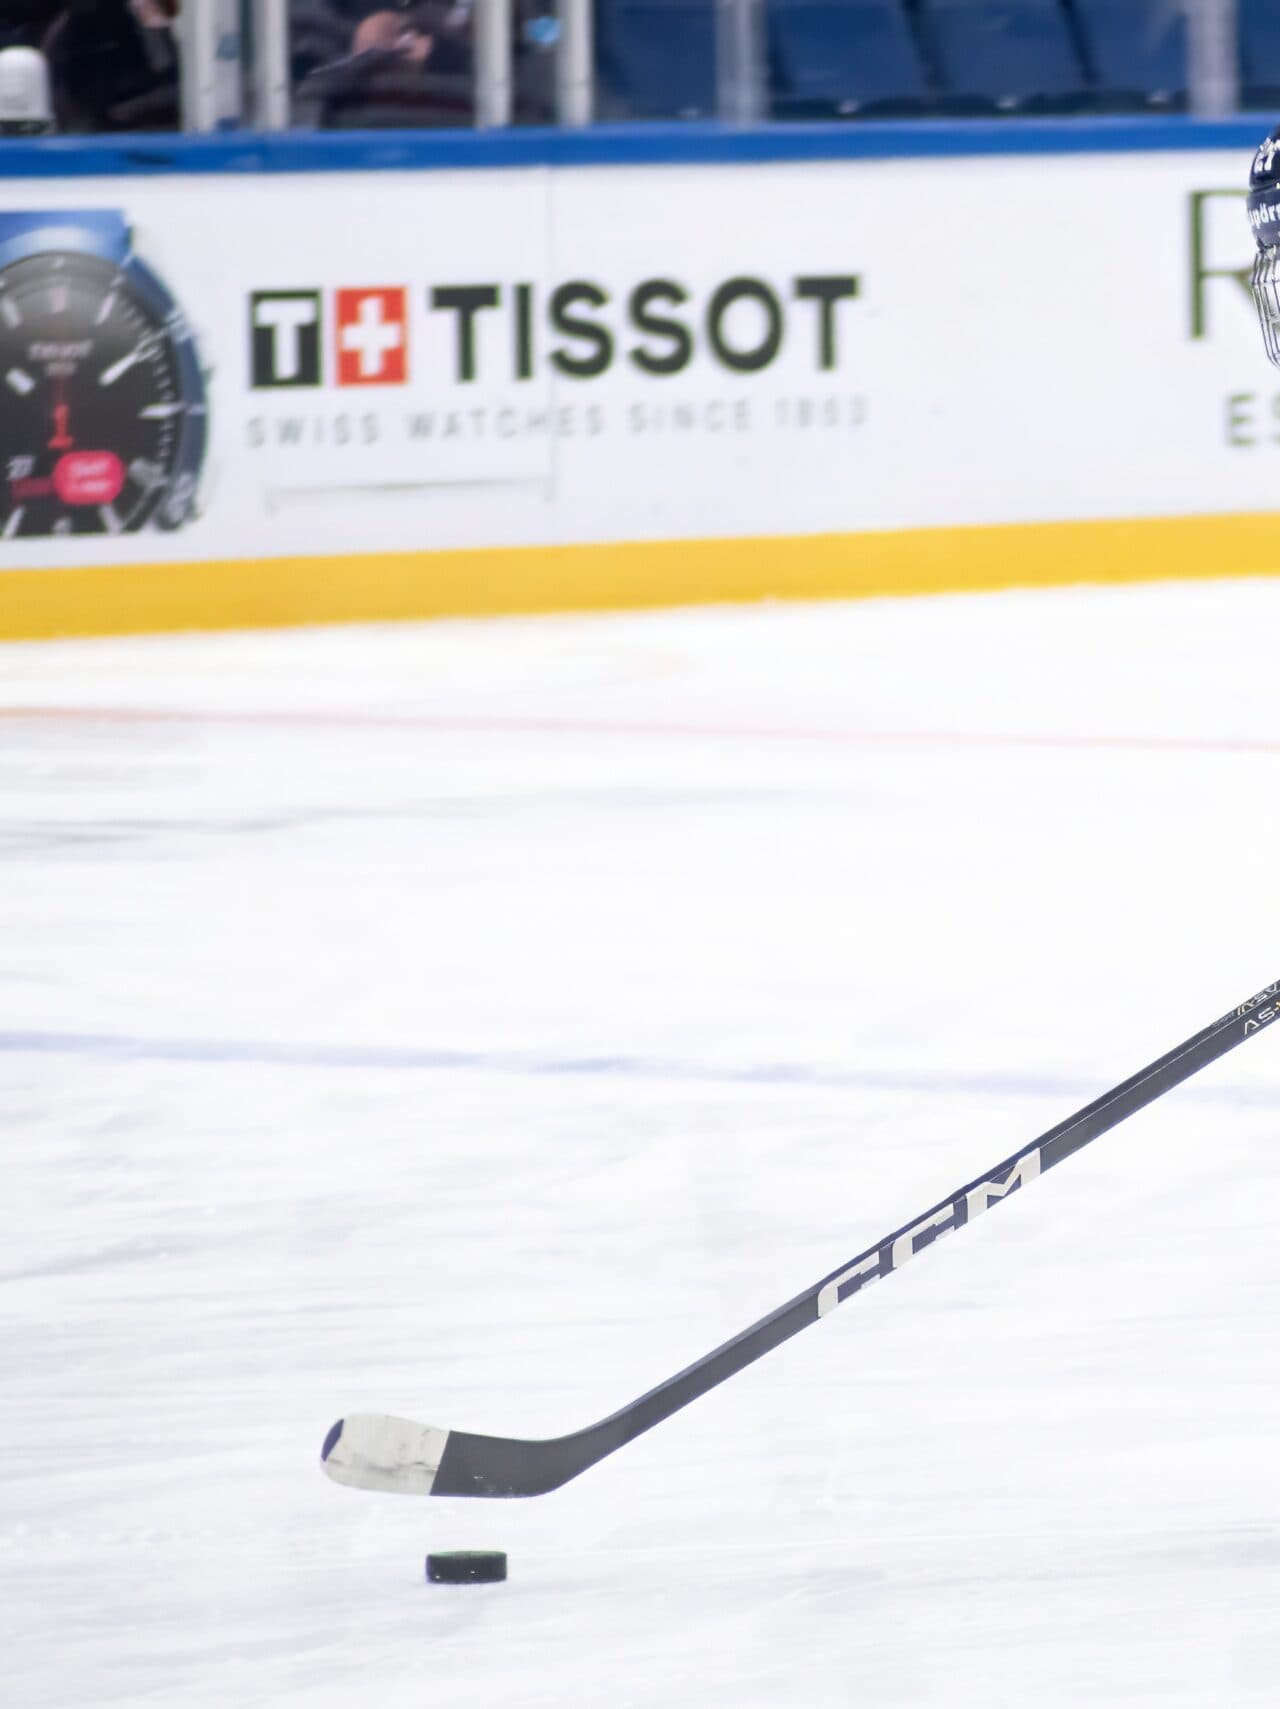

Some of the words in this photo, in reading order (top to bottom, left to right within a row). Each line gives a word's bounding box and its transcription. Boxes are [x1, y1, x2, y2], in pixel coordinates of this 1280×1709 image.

[429, 274, 861, 384] TISSOT
[246, 411, 379, 449] SWISS
[408, 402, 604, 440] WATCHES
[627, 396, 752, 436] SINCE
[817, 1147, 1041, 1318] CCM
